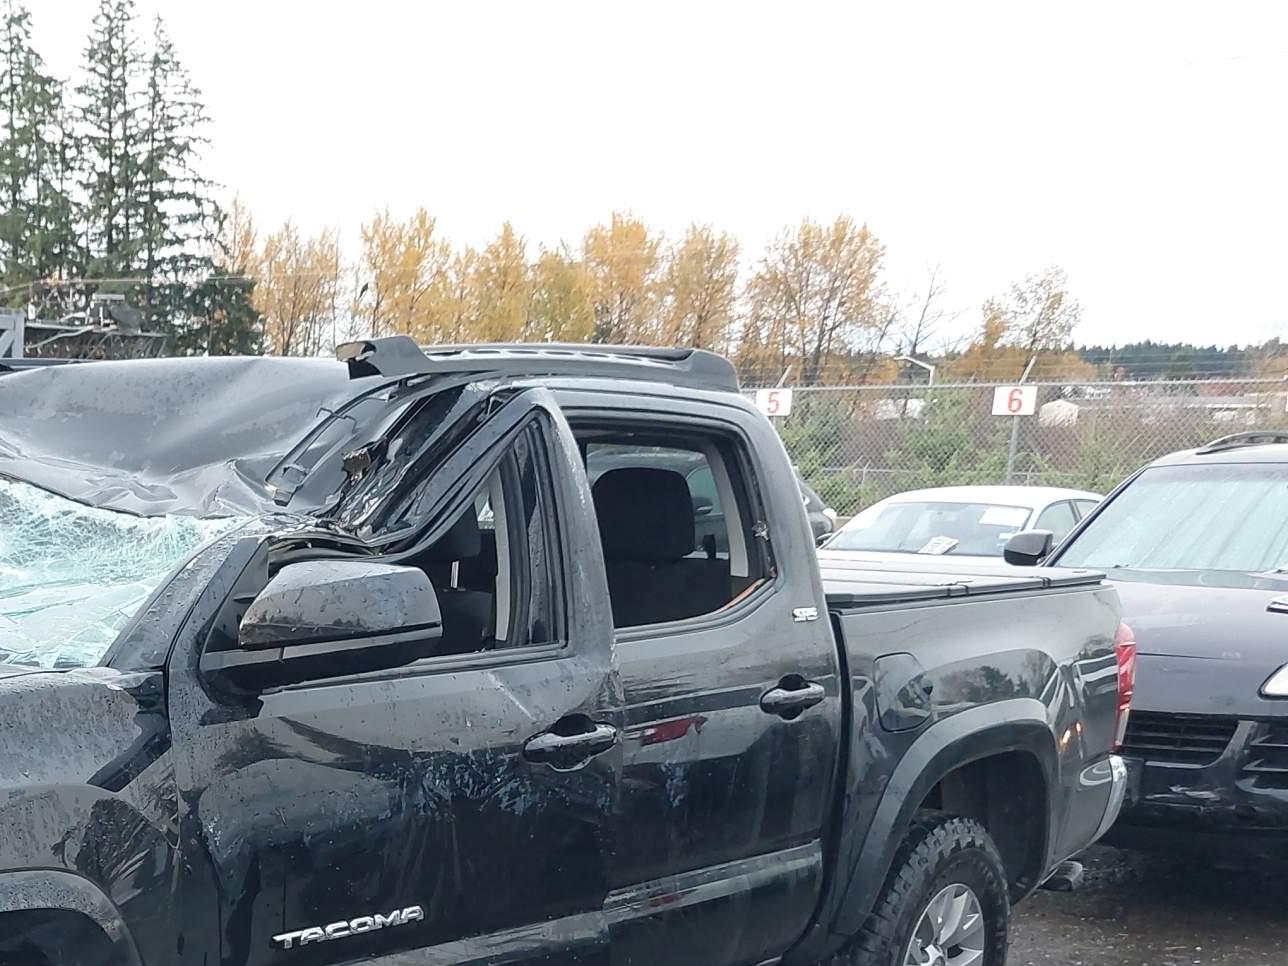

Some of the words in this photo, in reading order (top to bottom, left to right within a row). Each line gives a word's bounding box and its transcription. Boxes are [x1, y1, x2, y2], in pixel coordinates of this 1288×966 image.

[767, 391, 780, 414] 5
[1008, 388, 1023, 413] 6
[272, 905, 425, 949] TACOMA
